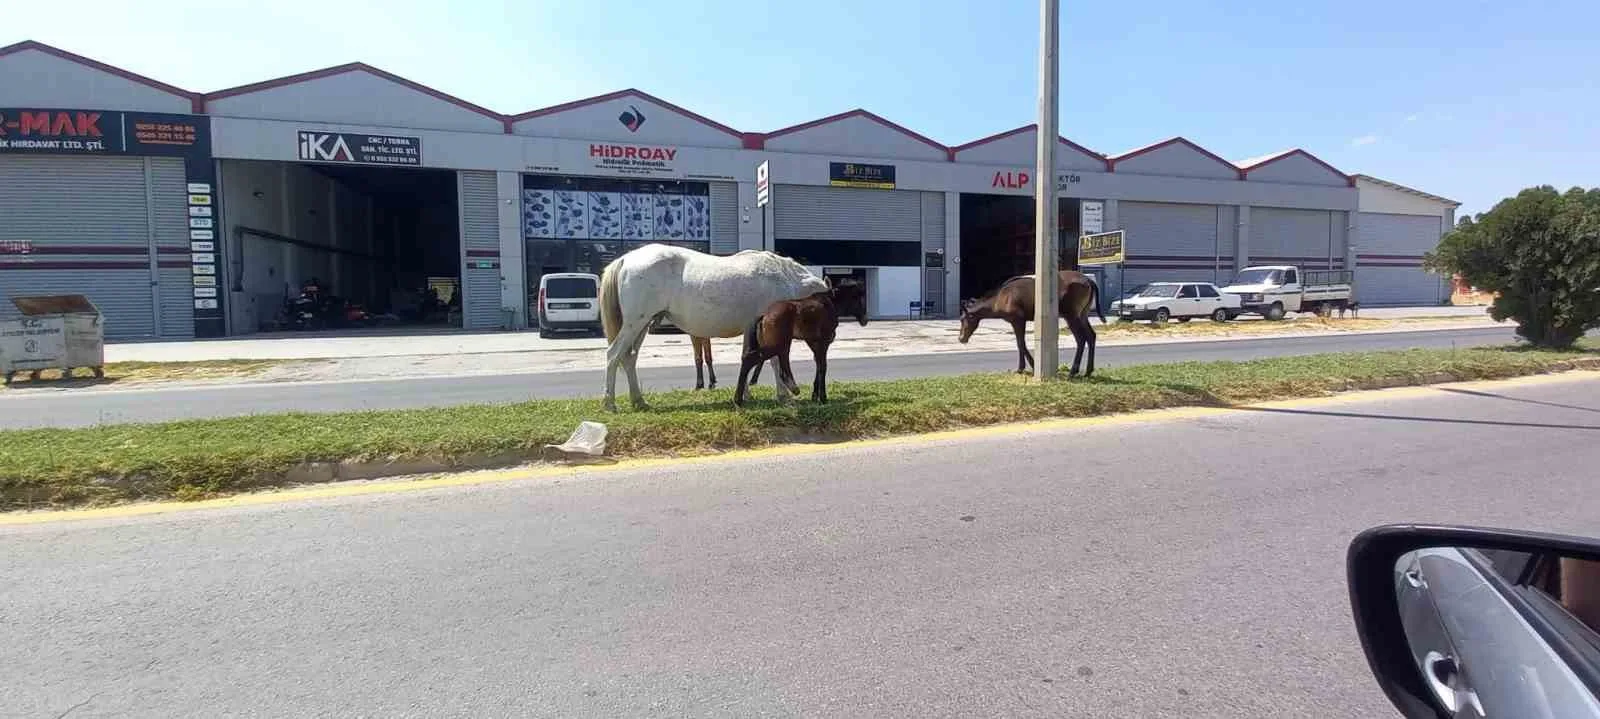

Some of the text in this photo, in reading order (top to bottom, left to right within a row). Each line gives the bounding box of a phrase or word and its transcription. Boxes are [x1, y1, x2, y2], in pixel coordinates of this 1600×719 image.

[11, 140, 61, 149] HIRDAVAT
[63, 141, 84, 150] LTD.
[992, 171, 1029, 189] ALP
